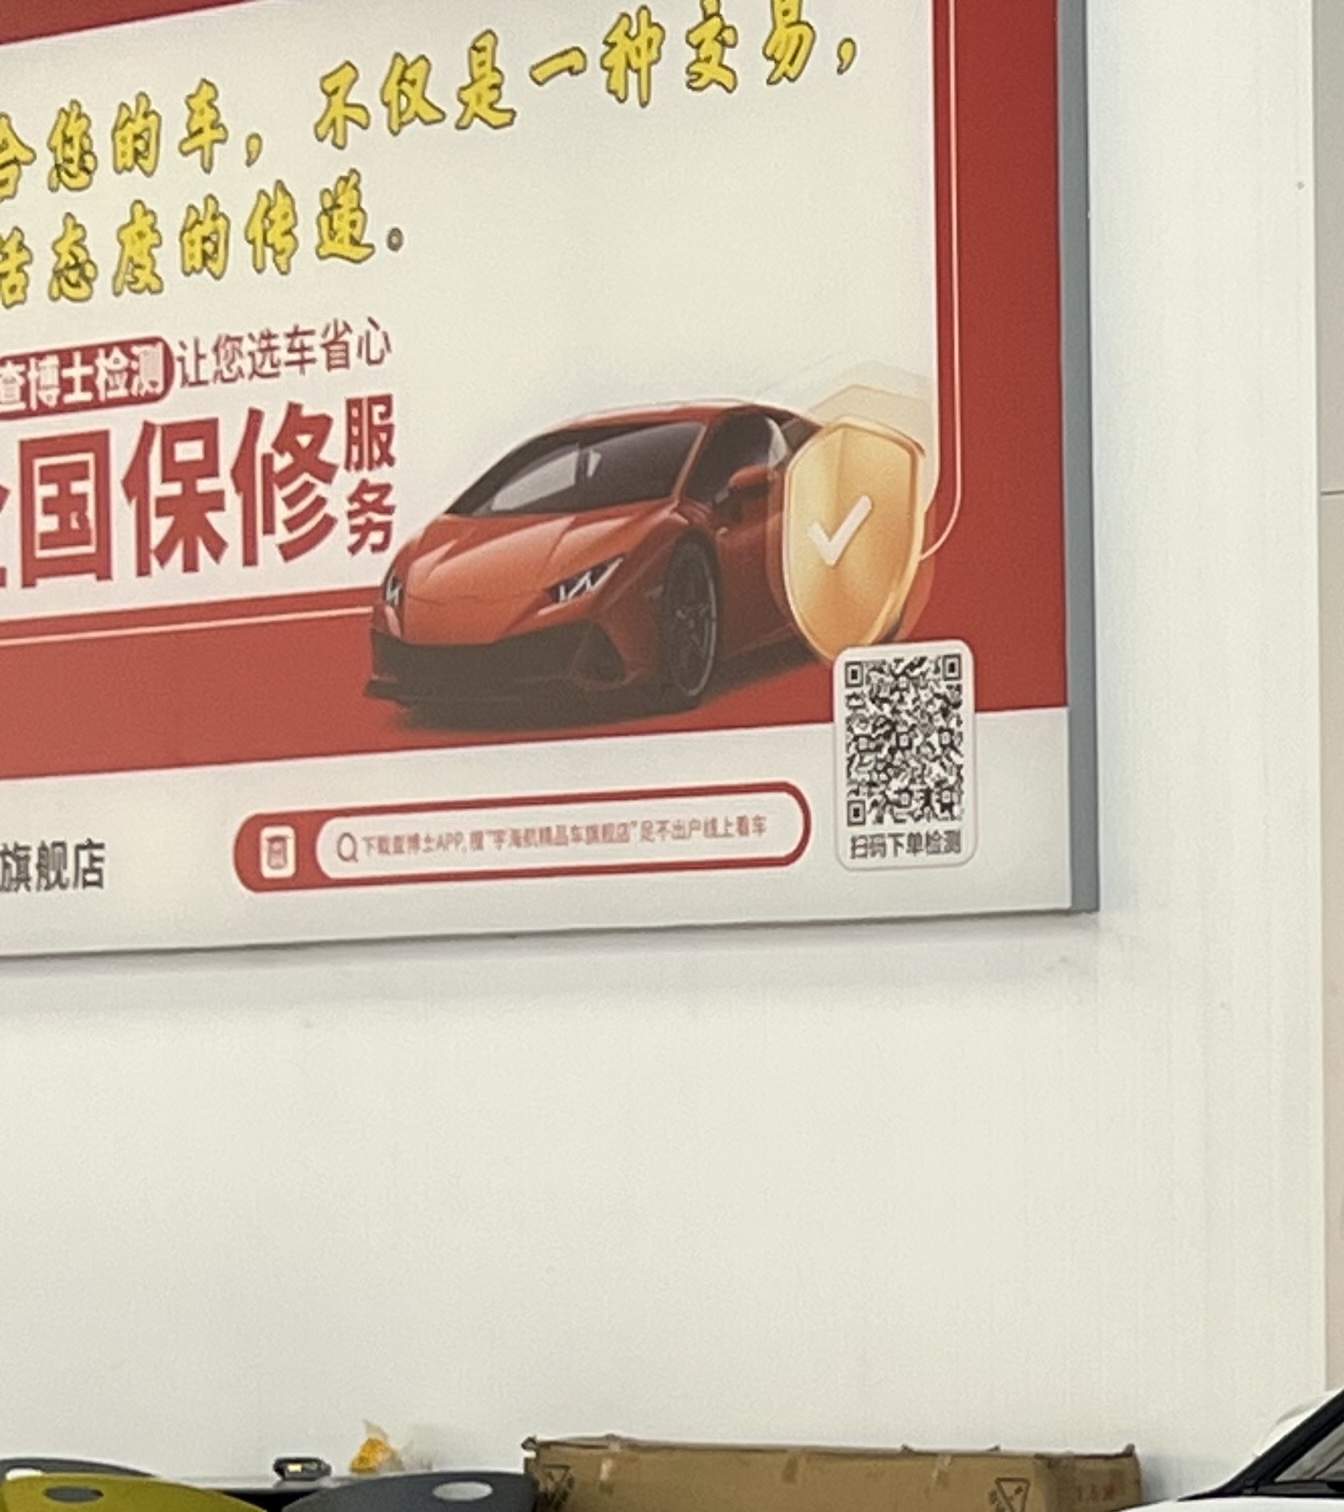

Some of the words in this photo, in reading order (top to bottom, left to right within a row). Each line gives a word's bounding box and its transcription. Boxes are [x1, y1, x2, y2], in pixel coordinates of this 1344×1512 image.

[176, 316, 393, 390] 让您选车省心
[0, 400, 341, 589] 国保修
[343, 393, 397, 558] 服务
[0, 837, 106, 893] 旗舰店
[849, 828, 963, 861] 扫码下单检测
